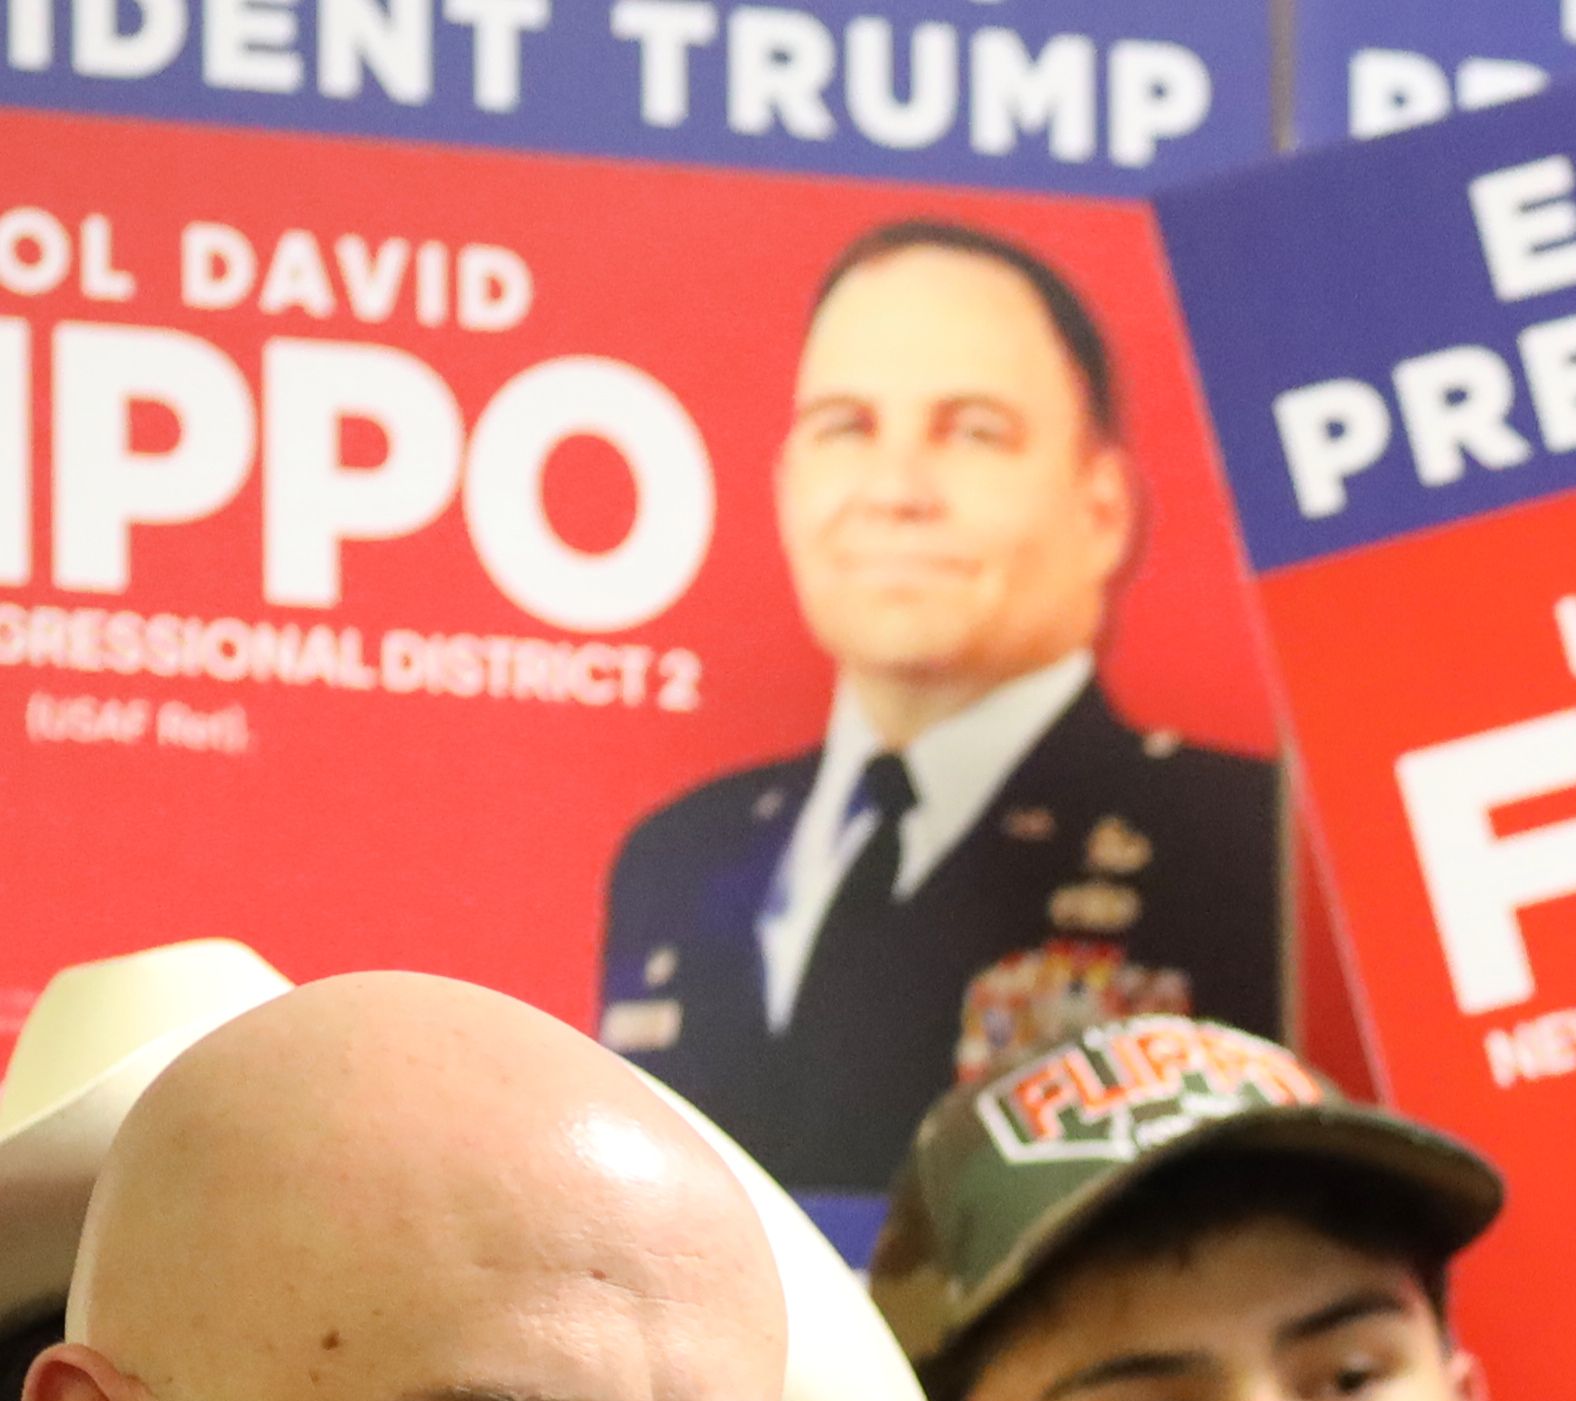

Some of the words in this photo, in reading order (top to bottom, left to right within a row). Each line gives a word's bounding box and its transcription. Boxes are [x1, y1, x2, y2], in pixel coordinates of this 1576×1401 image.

[6, 0, 552, 114] IDENT
[610, 0, 1213, 169] TRUMP
[0, 206, 138, 302] OL
[180, 218, 535, 333] DAVID
[0, 313, 718, 633] PPO
[0, 602, 378, 692] RESSIONAL
[380, 628, 654, 708] DISTRICT
[657, 646, 703, 714] 2
